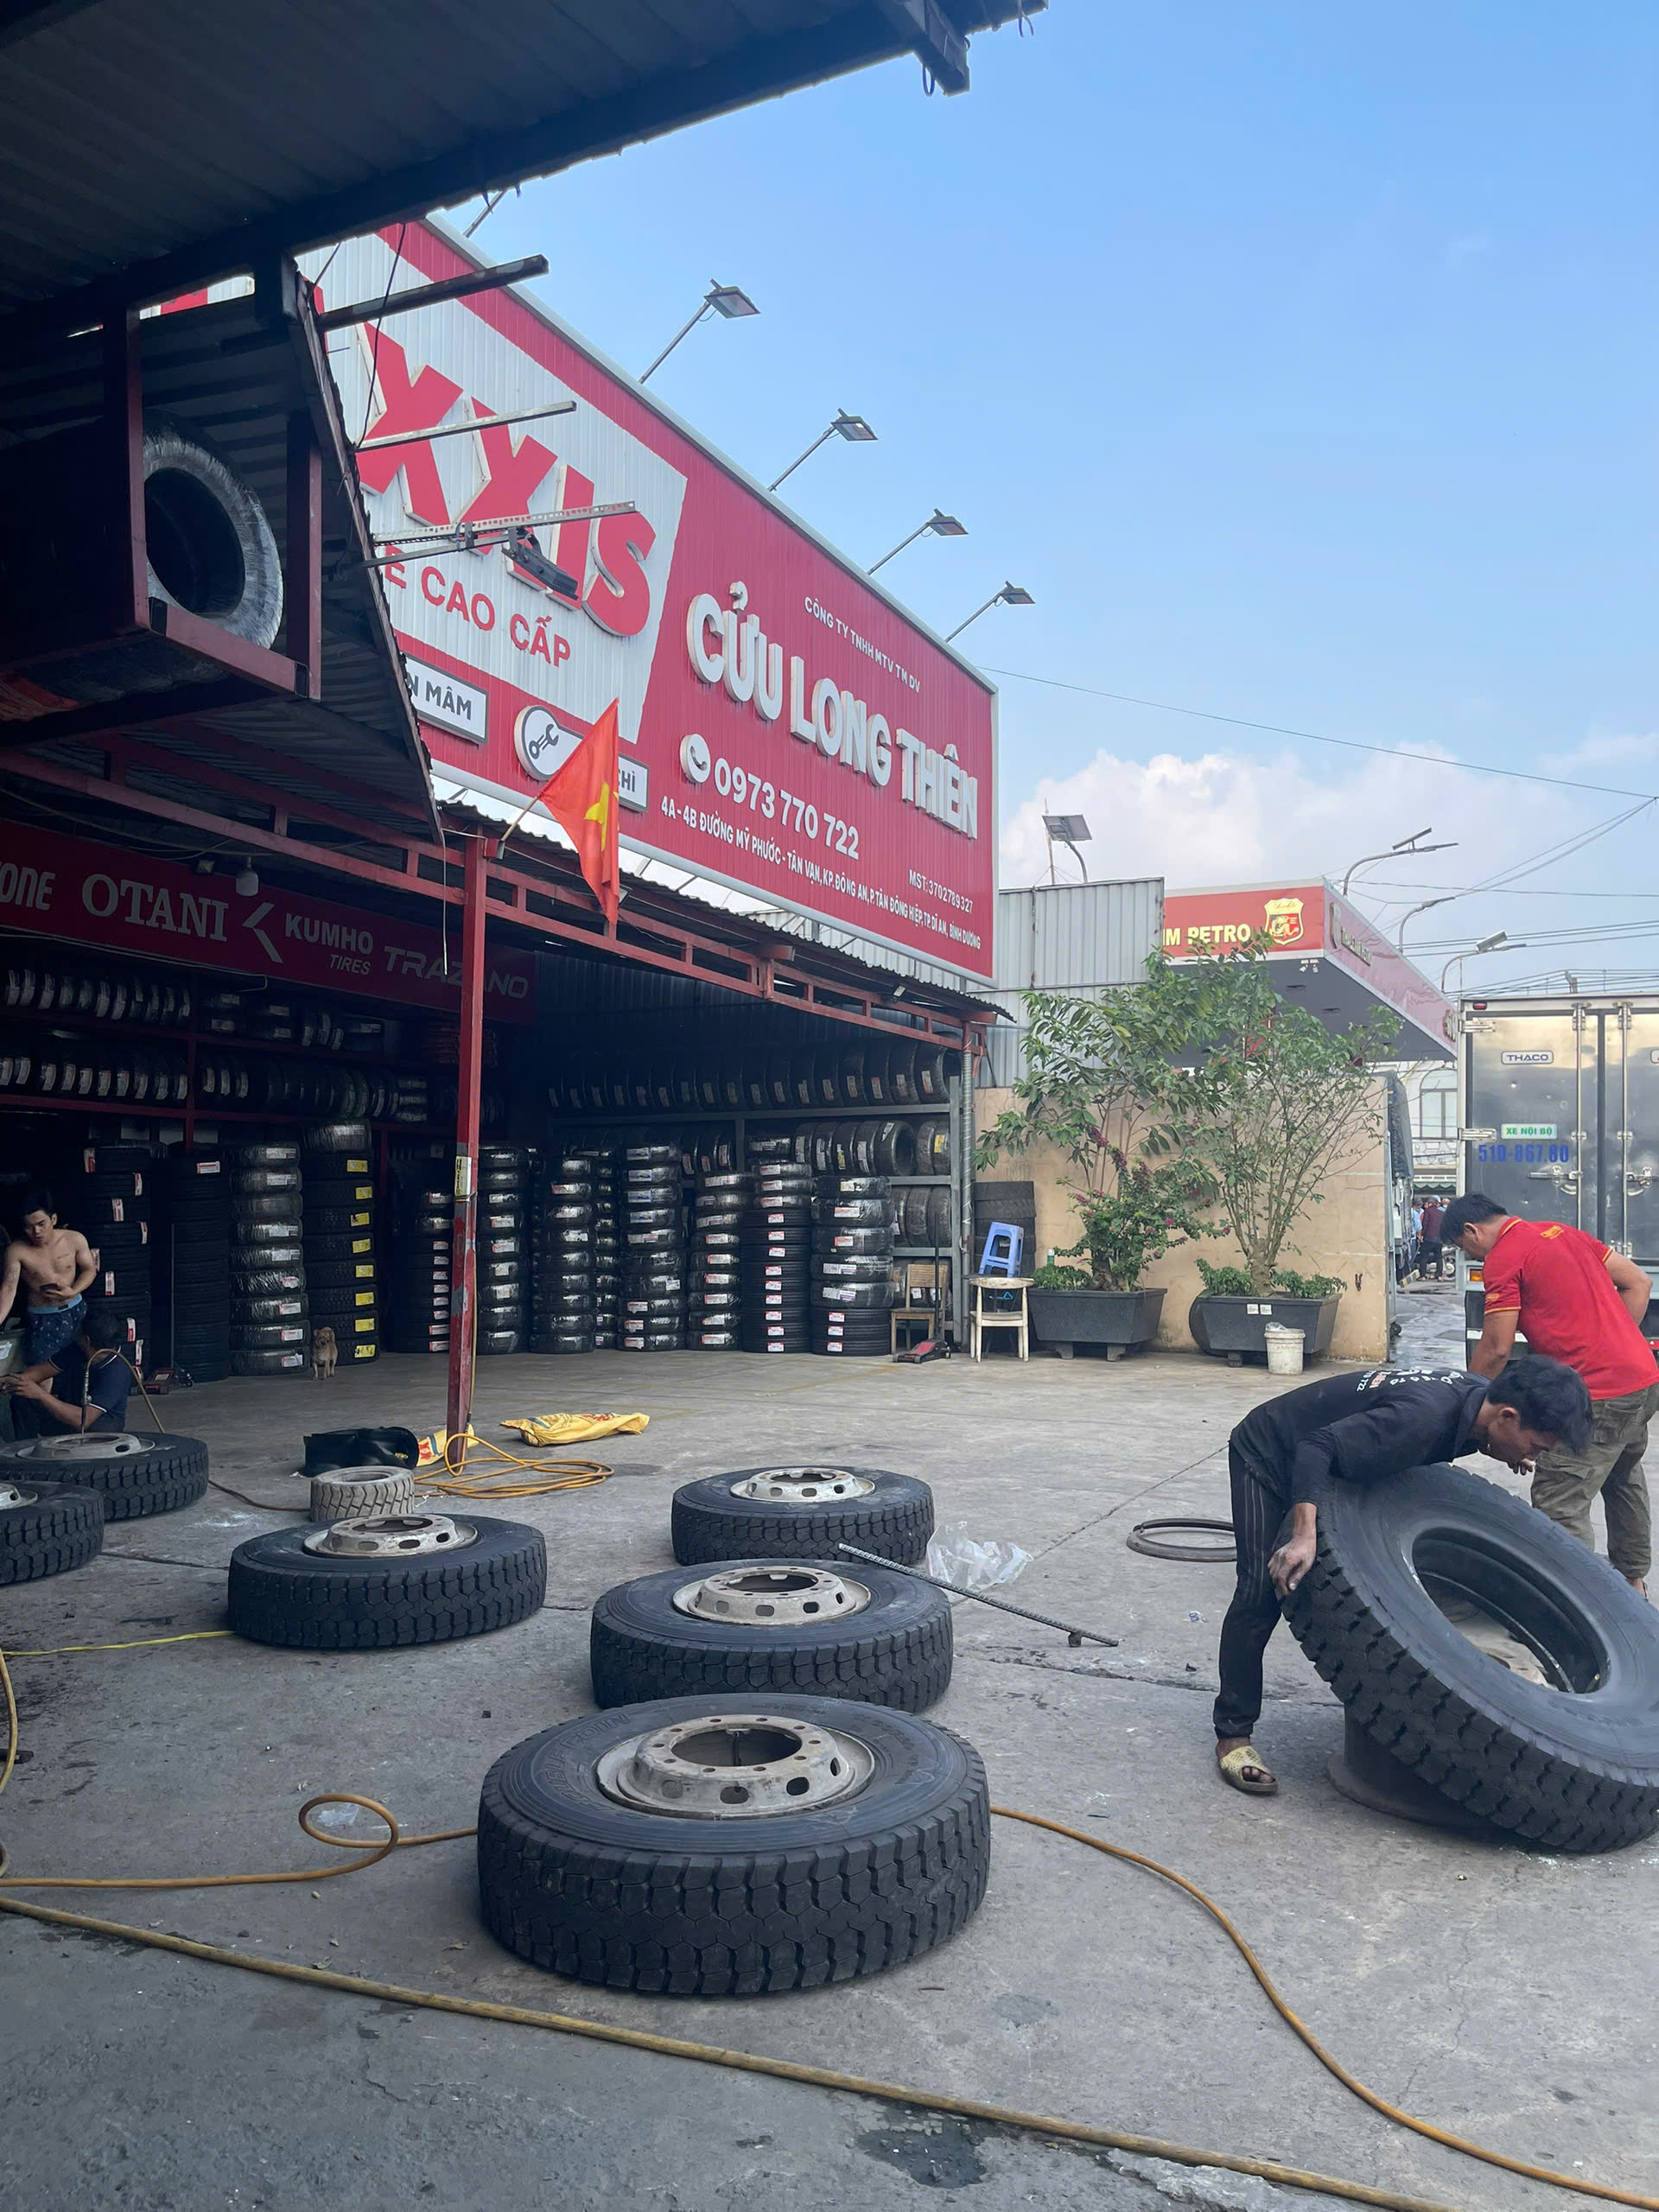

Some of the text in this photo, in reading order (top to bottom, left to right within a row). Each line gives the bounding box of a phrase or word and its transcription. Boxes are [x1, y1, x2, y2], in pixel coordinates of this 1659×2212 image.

[313, 281, 657, 637] XXIS
[374, 544, 571, 667] E CAO CẤP
[804, 597, 920, 694] CÔNG TY TNHH MTV TM DV
[426, 681, 472, 721] MÂM
[687, 581, 978, 840] CỬU LONG THIÊN
[618, 769, 636, 793] HÌ
[715, 758, 859, 861] 0973 770 722
[661, 796, 676, 819] 4A
[683, 805, 697, 829] 4B
[699, 810, 734, 844] ĐƯỜNG
[736, 827, 750, 851] MỸ
[752, 836, 781, 865] PHƯỚC
[787, 850, 803, 874] TÂN
[82, 874, 228, 942] OTANI
[909, 868, 974, 915] MST: 3702789327
[285, 912, 373, 955] KUMHO
[1188, 923, 1251, 945] PETRO
[329, 954, 371, 976] TIRES
[384, 945, 530, 999] TRAZNO
[1506, 1053, 1549, 1062] THACO
[1506, 1126, 1553, 1136] XE NỘI BỘ
